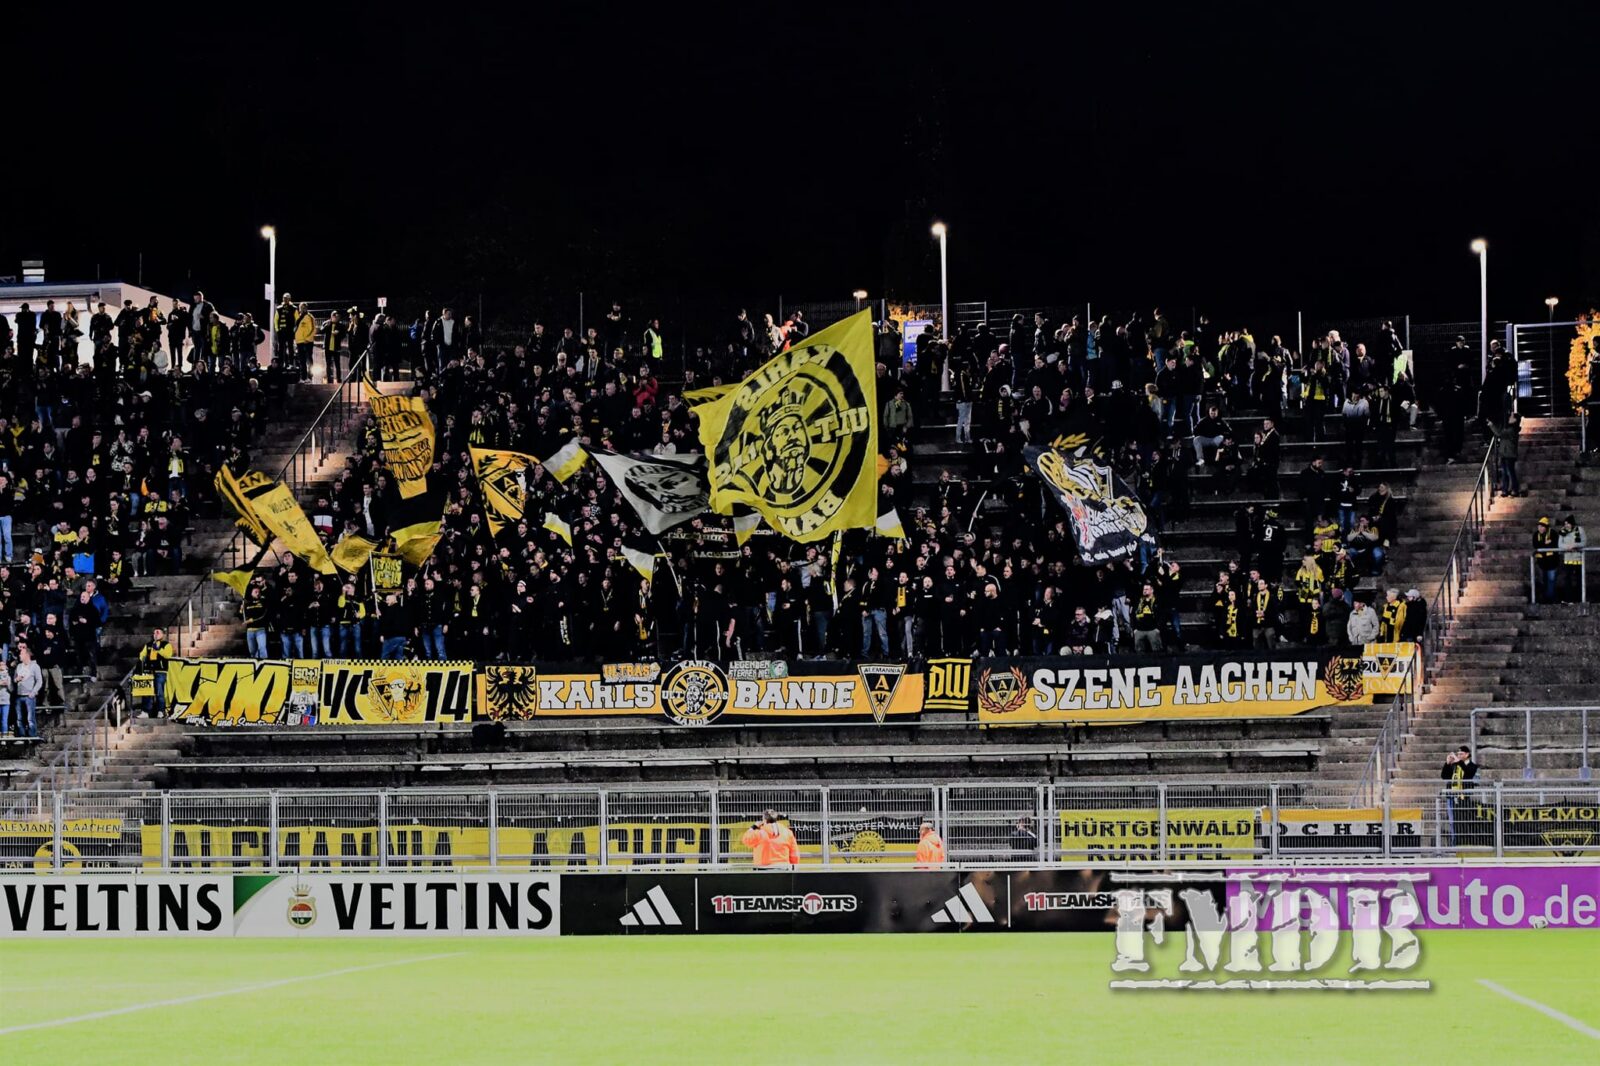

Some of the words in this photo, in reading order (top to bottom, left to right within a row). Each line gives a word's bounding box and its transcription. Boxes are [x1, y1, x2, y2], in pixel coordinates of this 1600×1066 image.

[1265, 527, 1273, 539] 9
[603, 664, 650, 677] ULTRAS
[680, 660, 716, 671] KARLS
[729, 660, 771, 669] LEGENDEN
[874, 675, 889, 690] A
[1033, 666, 1161, 711] SZENE
[1173, 661, 1318, 705] AACHEN
[539, 681, 655, 709] KARLS
[734, 680, 856, 710] BANDE
[1509, 807, 1600, 823] MEMO
[1064, 817, 1252, 838] HÜRTGENWALD
[3, 883, 222, 932] VELTINS
[329, 881, 553, 931] VELTINS
[712, 893, 857, 914] 11TEAMSPORTS
